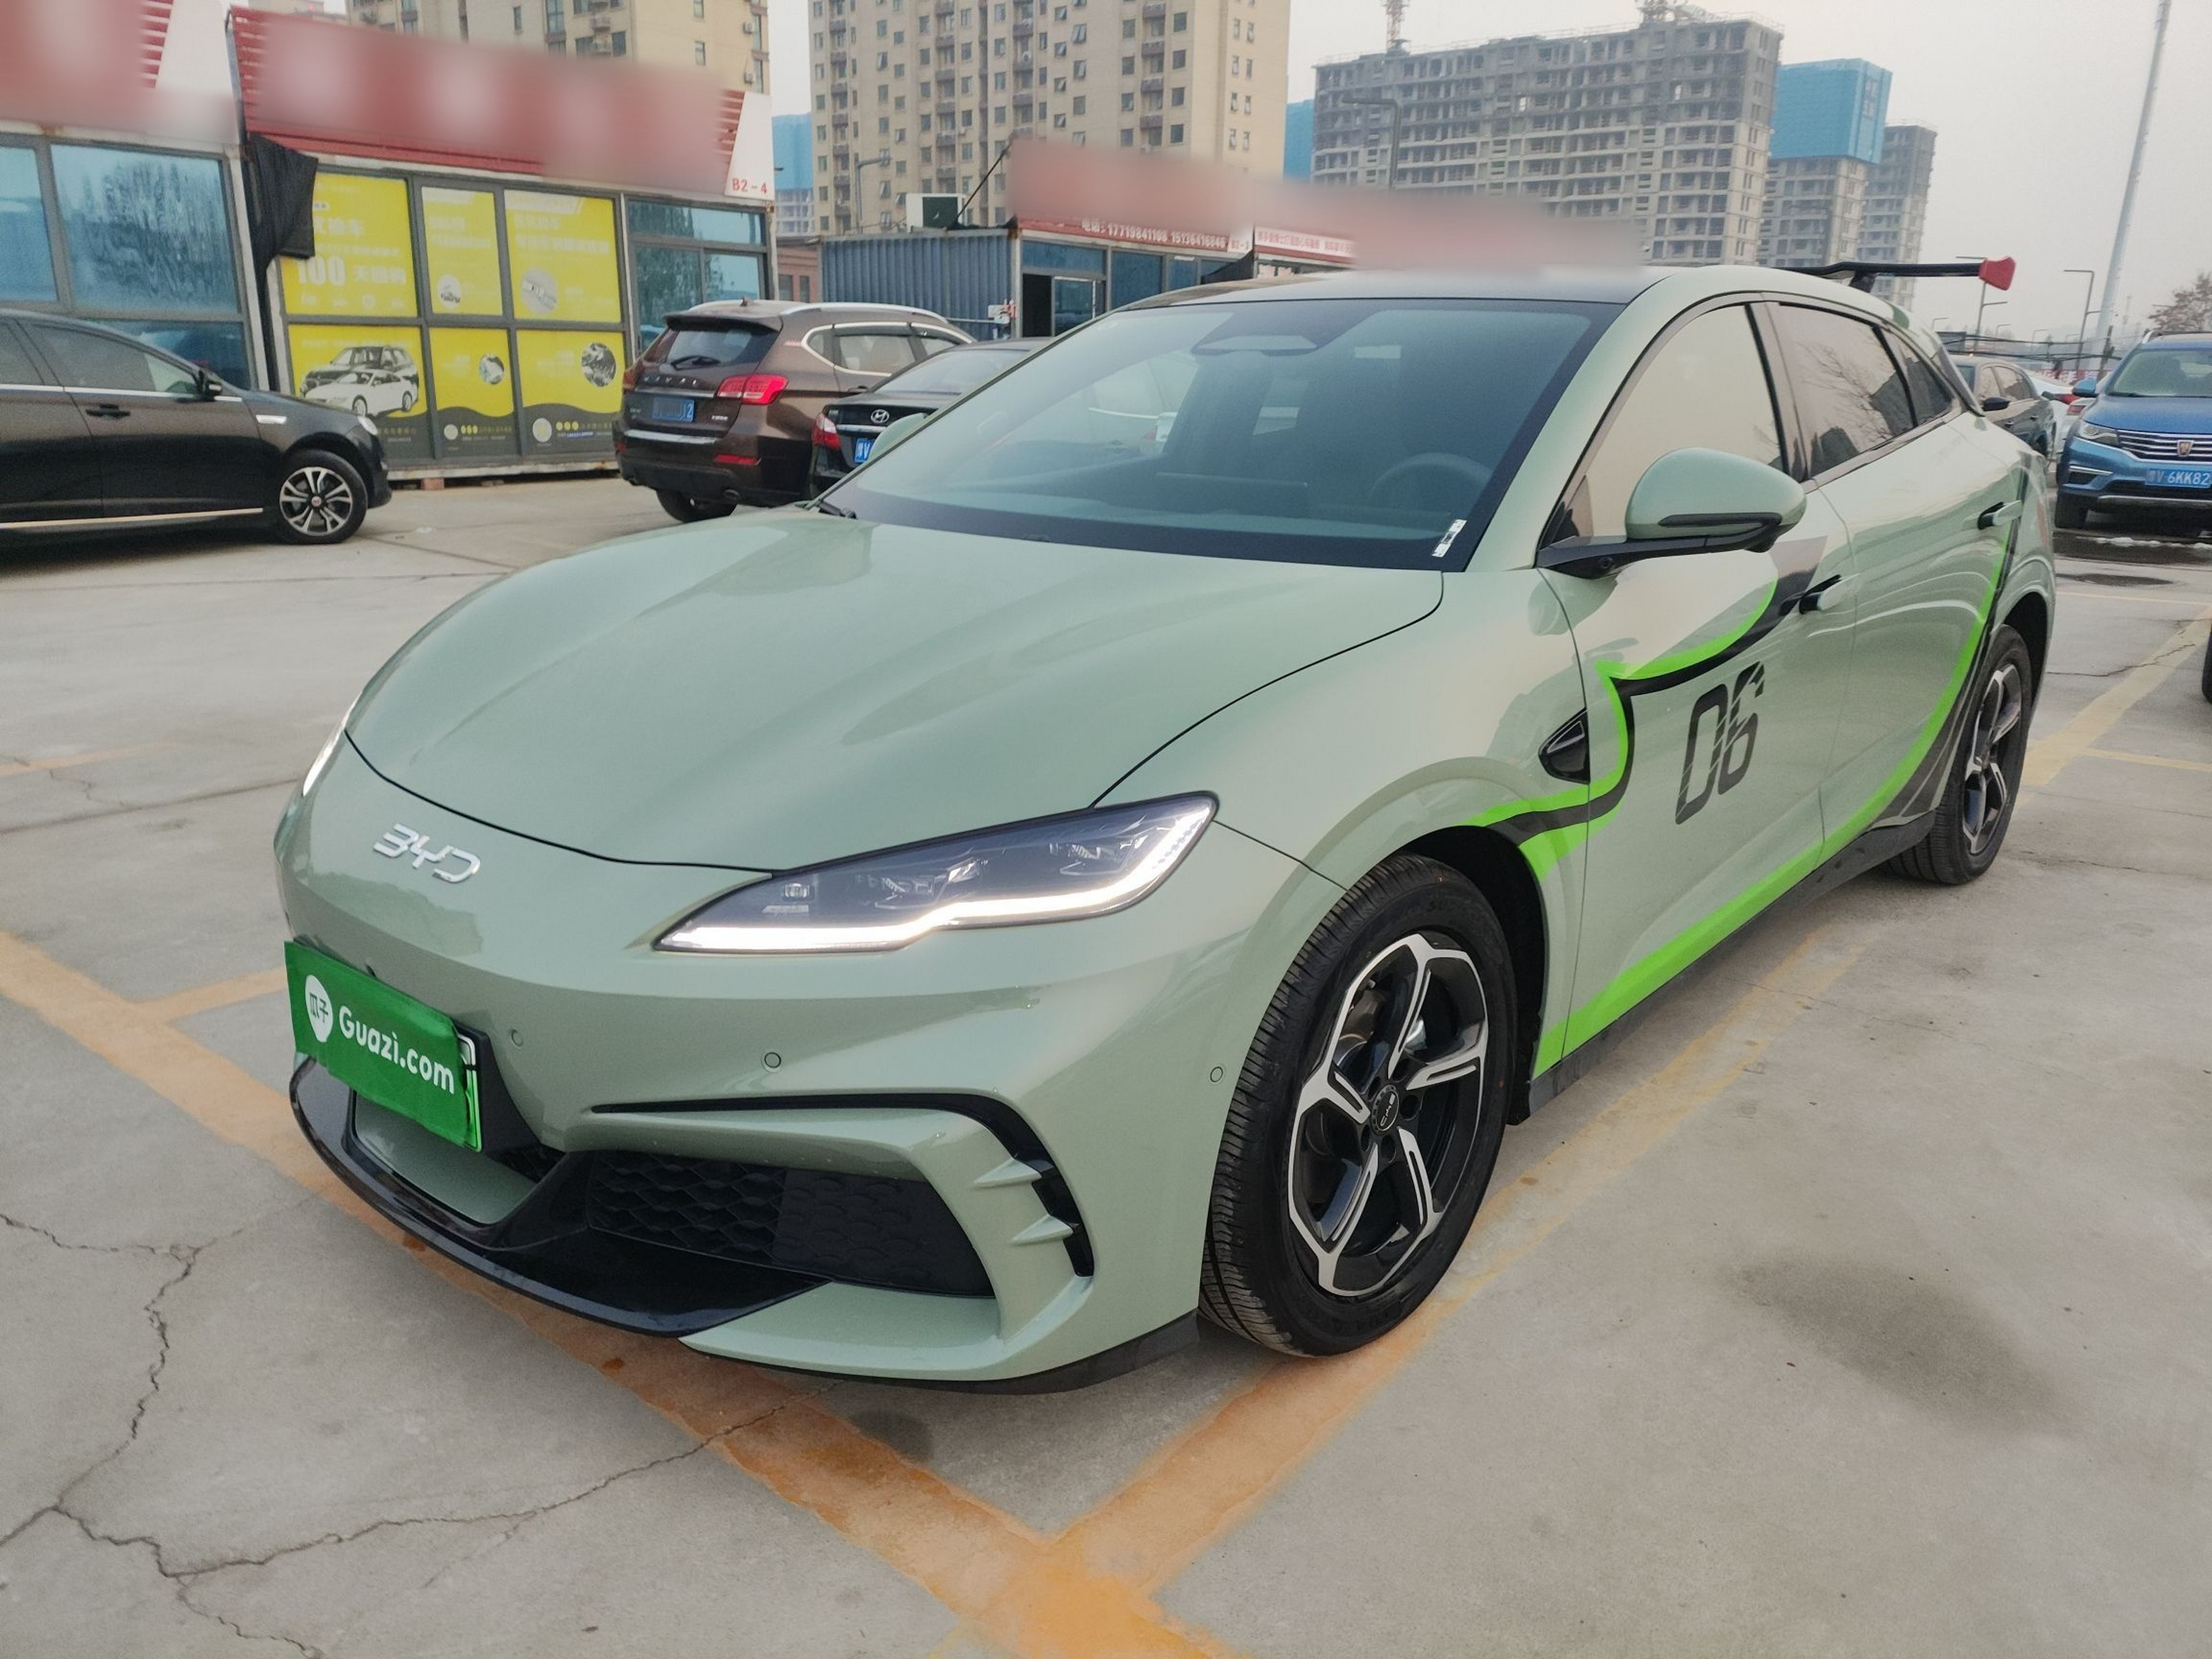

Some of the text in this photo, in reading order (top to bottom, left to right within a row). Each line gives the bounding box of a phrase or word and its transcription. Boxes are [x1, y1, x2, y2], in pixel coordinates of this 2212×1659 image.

[732, 178, 767, 194] B2-4
[1675, 661, 1765, 825] 06
[373, 823, 480, 884] BYD
[339, 1005, 454, 1094] Guazi.com
